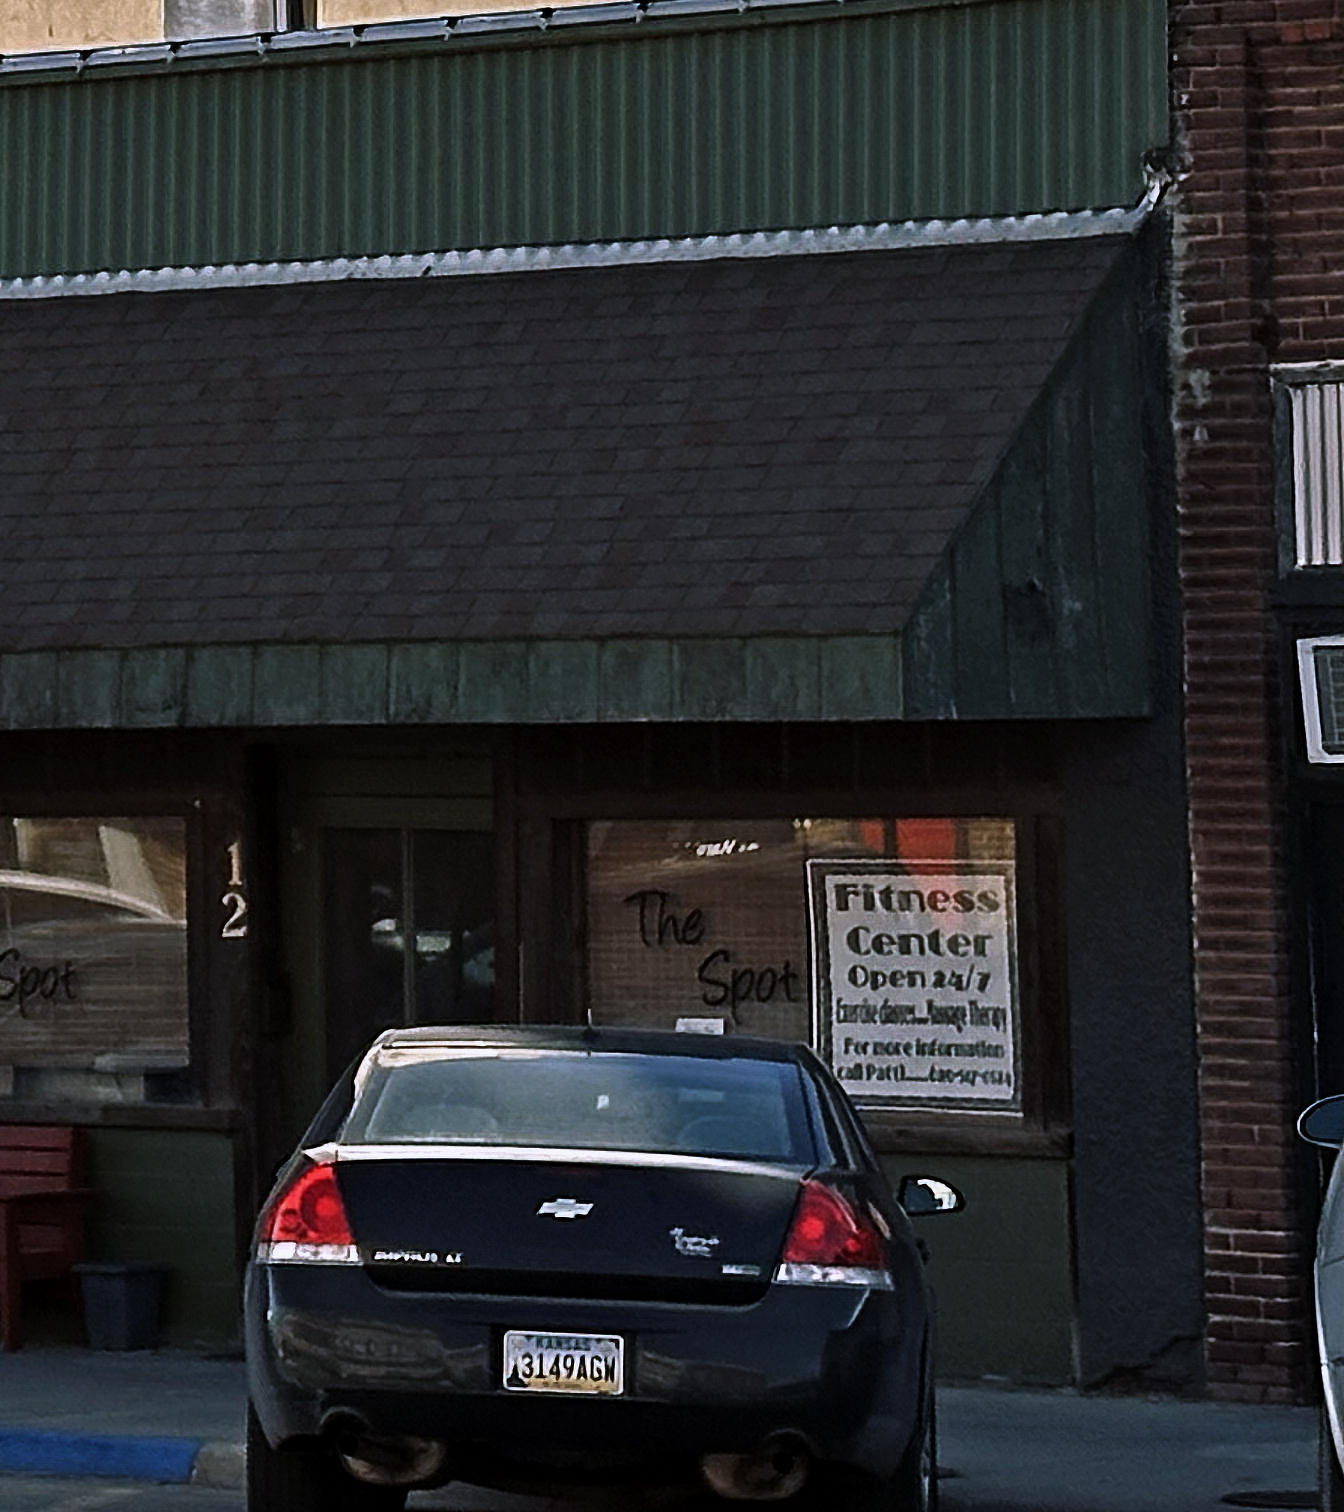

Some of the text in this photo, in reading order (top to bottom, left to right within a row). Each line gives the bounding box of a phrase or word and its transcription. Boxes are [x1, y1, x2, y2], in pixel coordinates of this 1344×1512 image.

[834, 883, 1002, 914] Fitness
[623, 890, 705, 947] The
[846, 925, 994, 958] Center
[698, 949, 799, 1026] Spot
[847, 963, 992, 993] Open 24/7
[844, 1037, 1004, 1059] For more information
[837, 1063, 862, 1080] call
